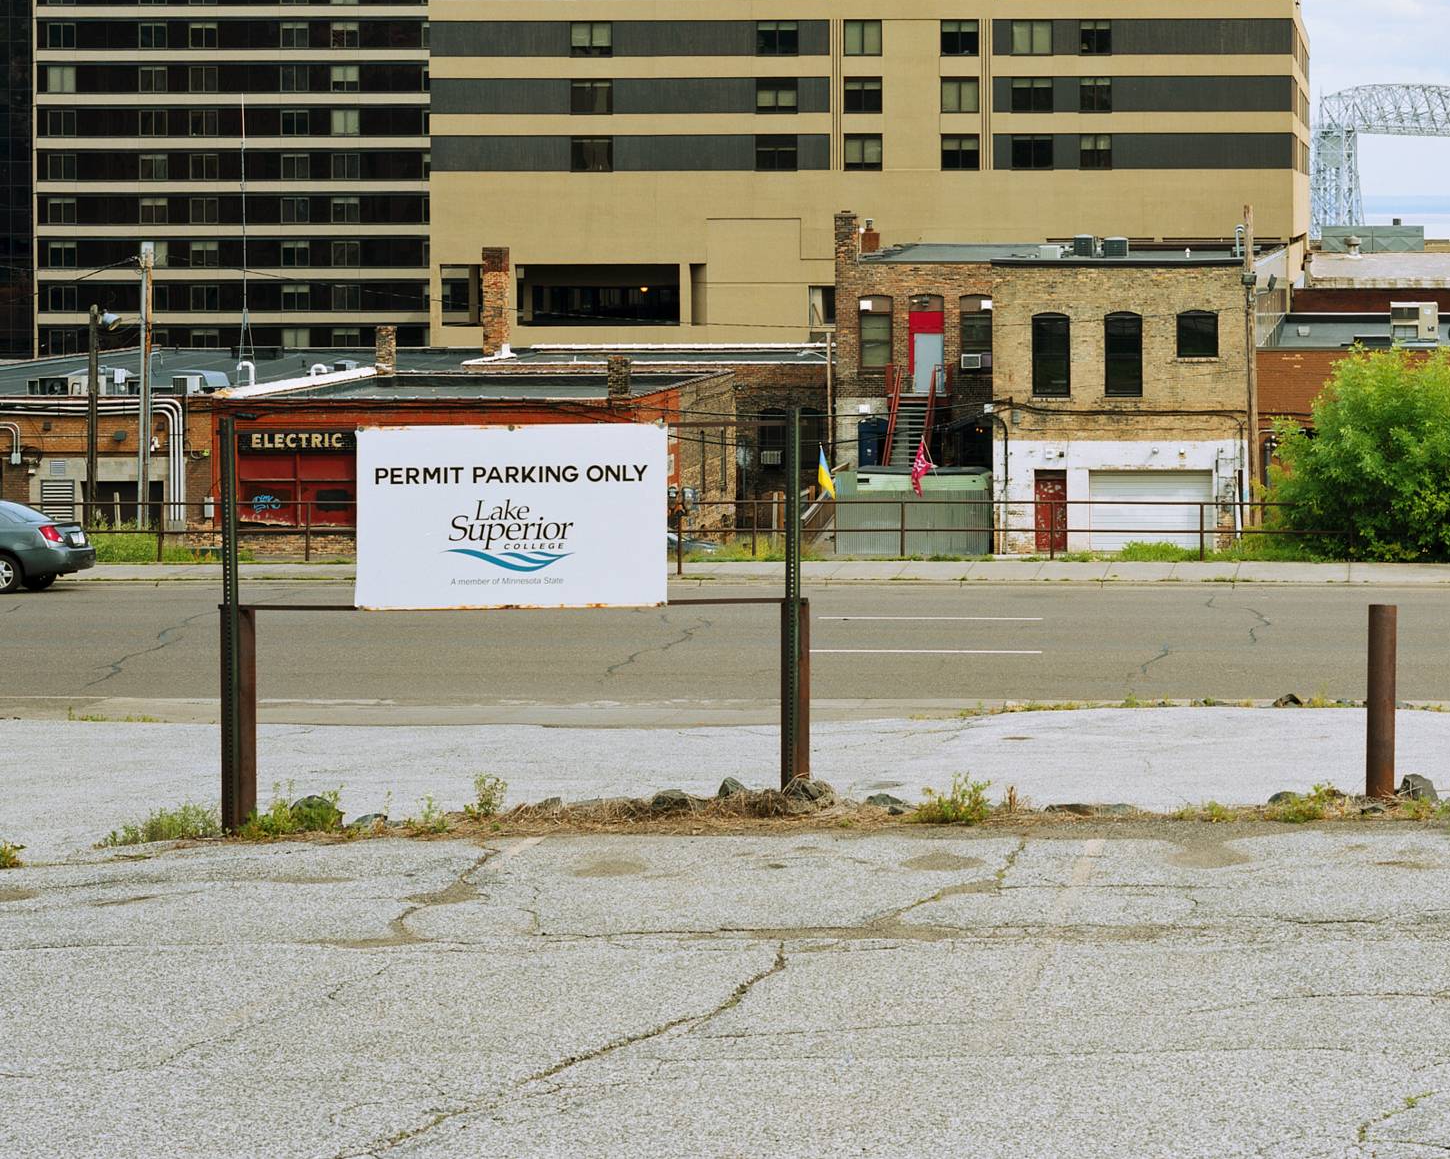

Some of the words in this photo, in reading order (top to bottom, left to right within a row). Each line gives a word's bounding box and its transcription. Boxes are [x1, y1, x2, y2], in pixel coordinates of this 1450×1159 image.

[251, 433, 343, 448] ELECTRIC
[375, 466, 465, 485] PERMIT
[472, 465, 579, 484] PARKING
[586, 464, 649, 483] ONLY
[475, 498, 530, 521] Lake
[448, 514, 574, 550] Superior
[450, 578, 457, 586] A
[458, 578, 490, 586] member
[491, 577, 501, 585] of
[501, 577, 542, 585] Minnesota
[544, 576, 564, 585] State
